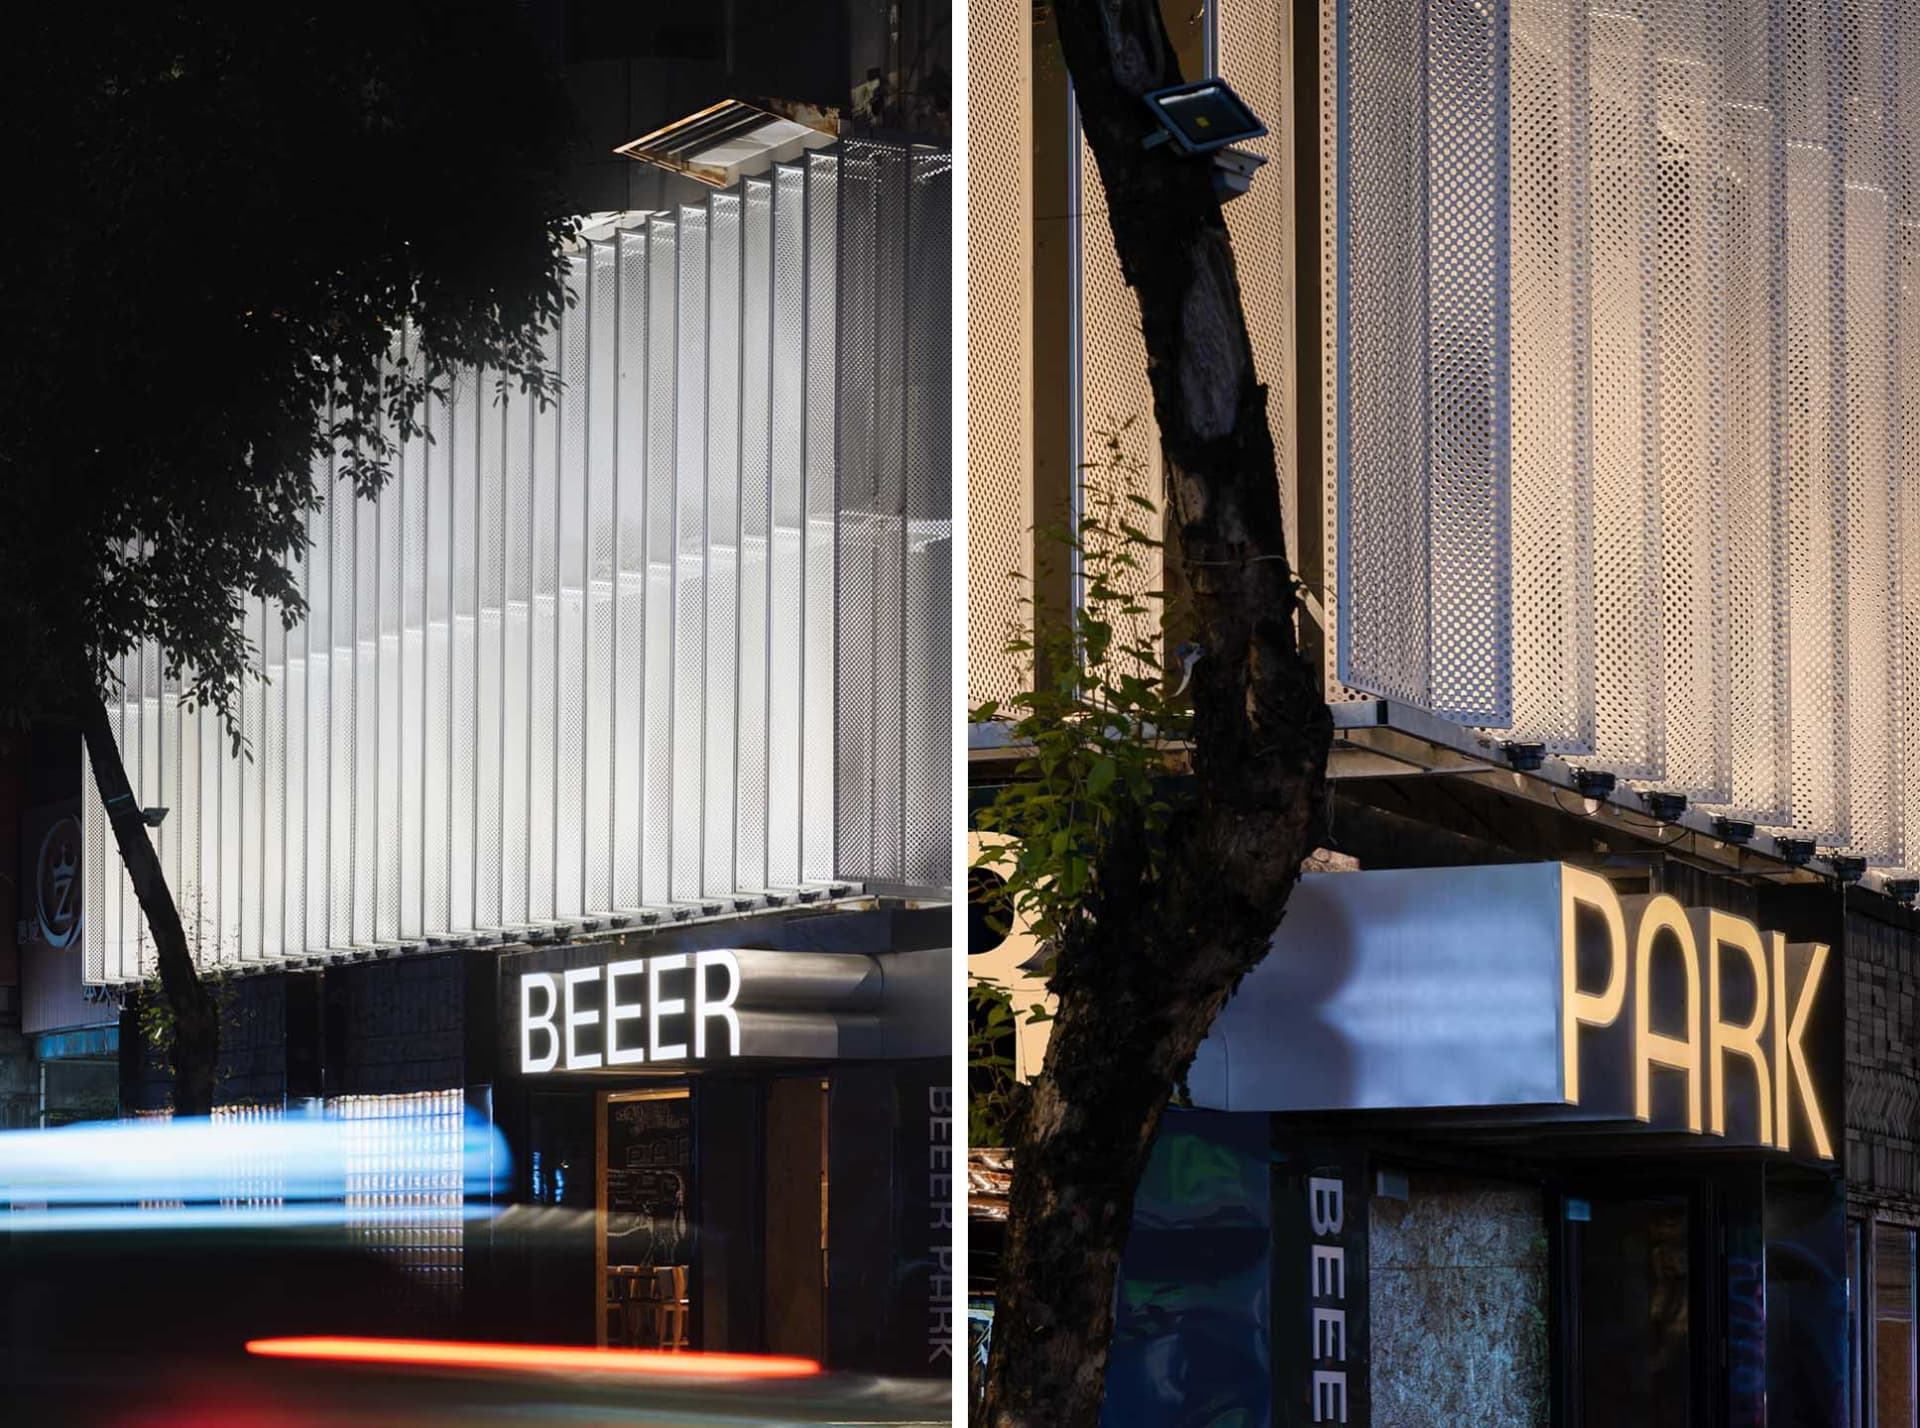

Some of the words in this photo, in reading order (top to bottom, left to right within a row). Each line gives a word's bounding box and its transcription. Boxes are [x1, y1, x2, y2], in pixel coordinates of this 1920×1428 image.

[53, 877, 73, 922] Z
[521, 949, 741, 1074] BEEER
[1560, 861, 1834, 1160] PARK
[928, 1085, 952, 1230] BEEER
[1308, 1176, 1348, 1424] BEEE
